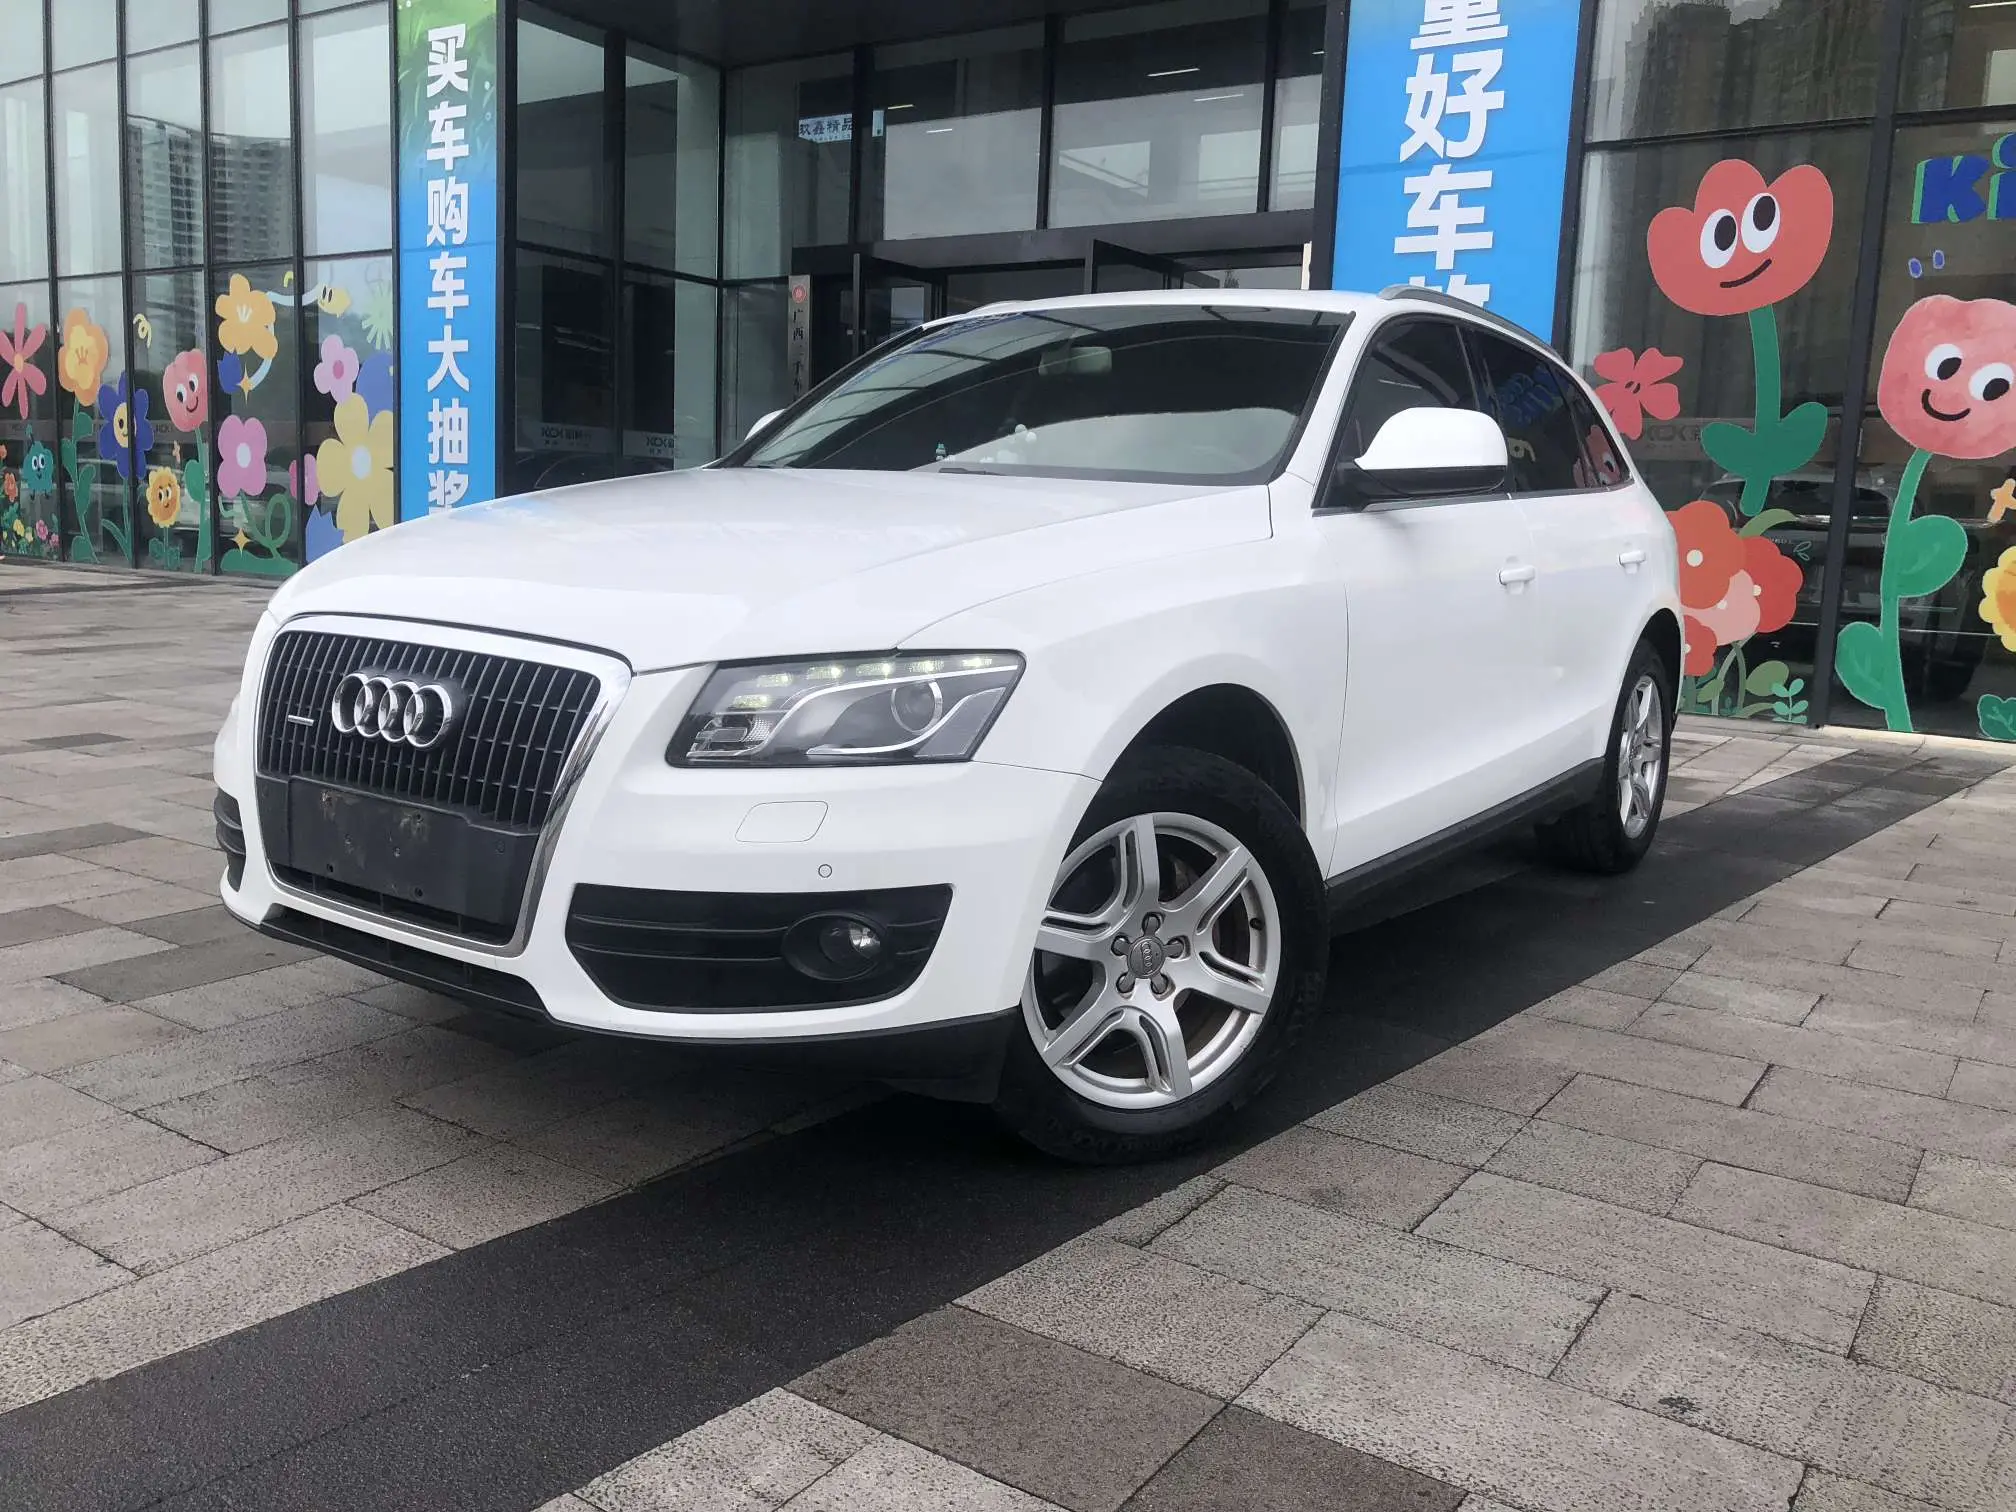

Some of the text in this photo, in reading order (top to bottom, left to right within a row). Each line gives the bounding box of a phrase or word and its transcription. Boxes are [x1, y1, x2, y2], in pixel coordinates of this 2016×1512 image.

[427, 23, 469, 513] 买车购车大抽奖
[1394, 0, 1509, 307] 好车
